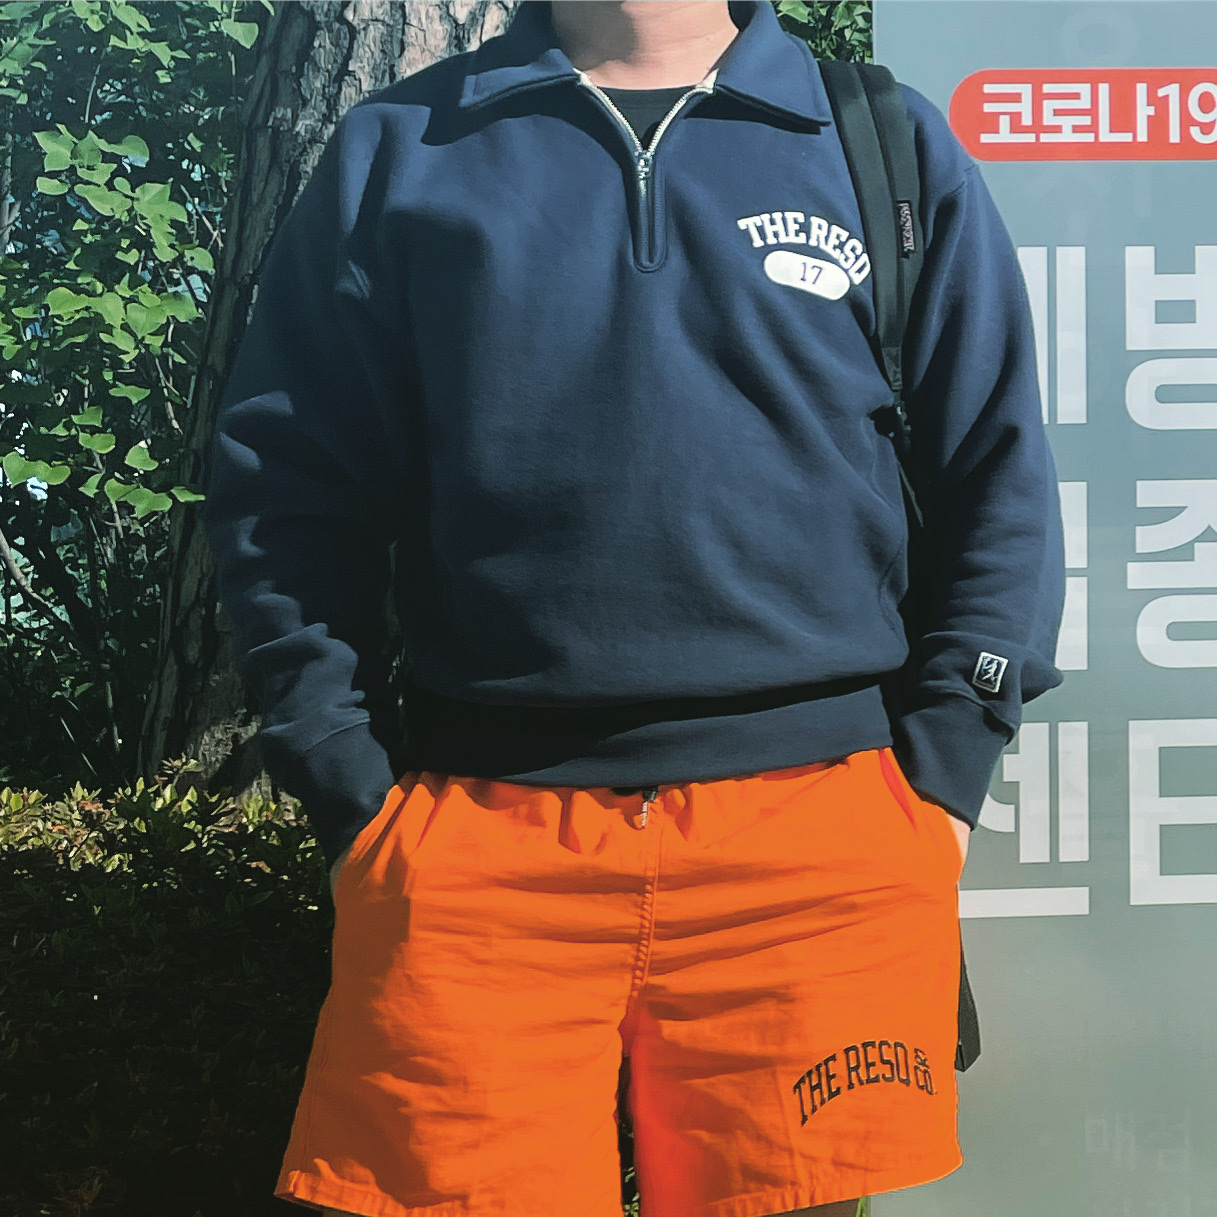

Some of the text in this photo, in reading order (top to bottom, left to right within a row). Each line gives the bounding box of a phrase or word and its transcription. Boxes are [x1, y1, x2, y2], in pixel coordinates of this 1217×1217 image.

[736, 210, 808, 248] THE
[799, 261, 825, 286] 17
[793, 1052, 842, 1128] THE
